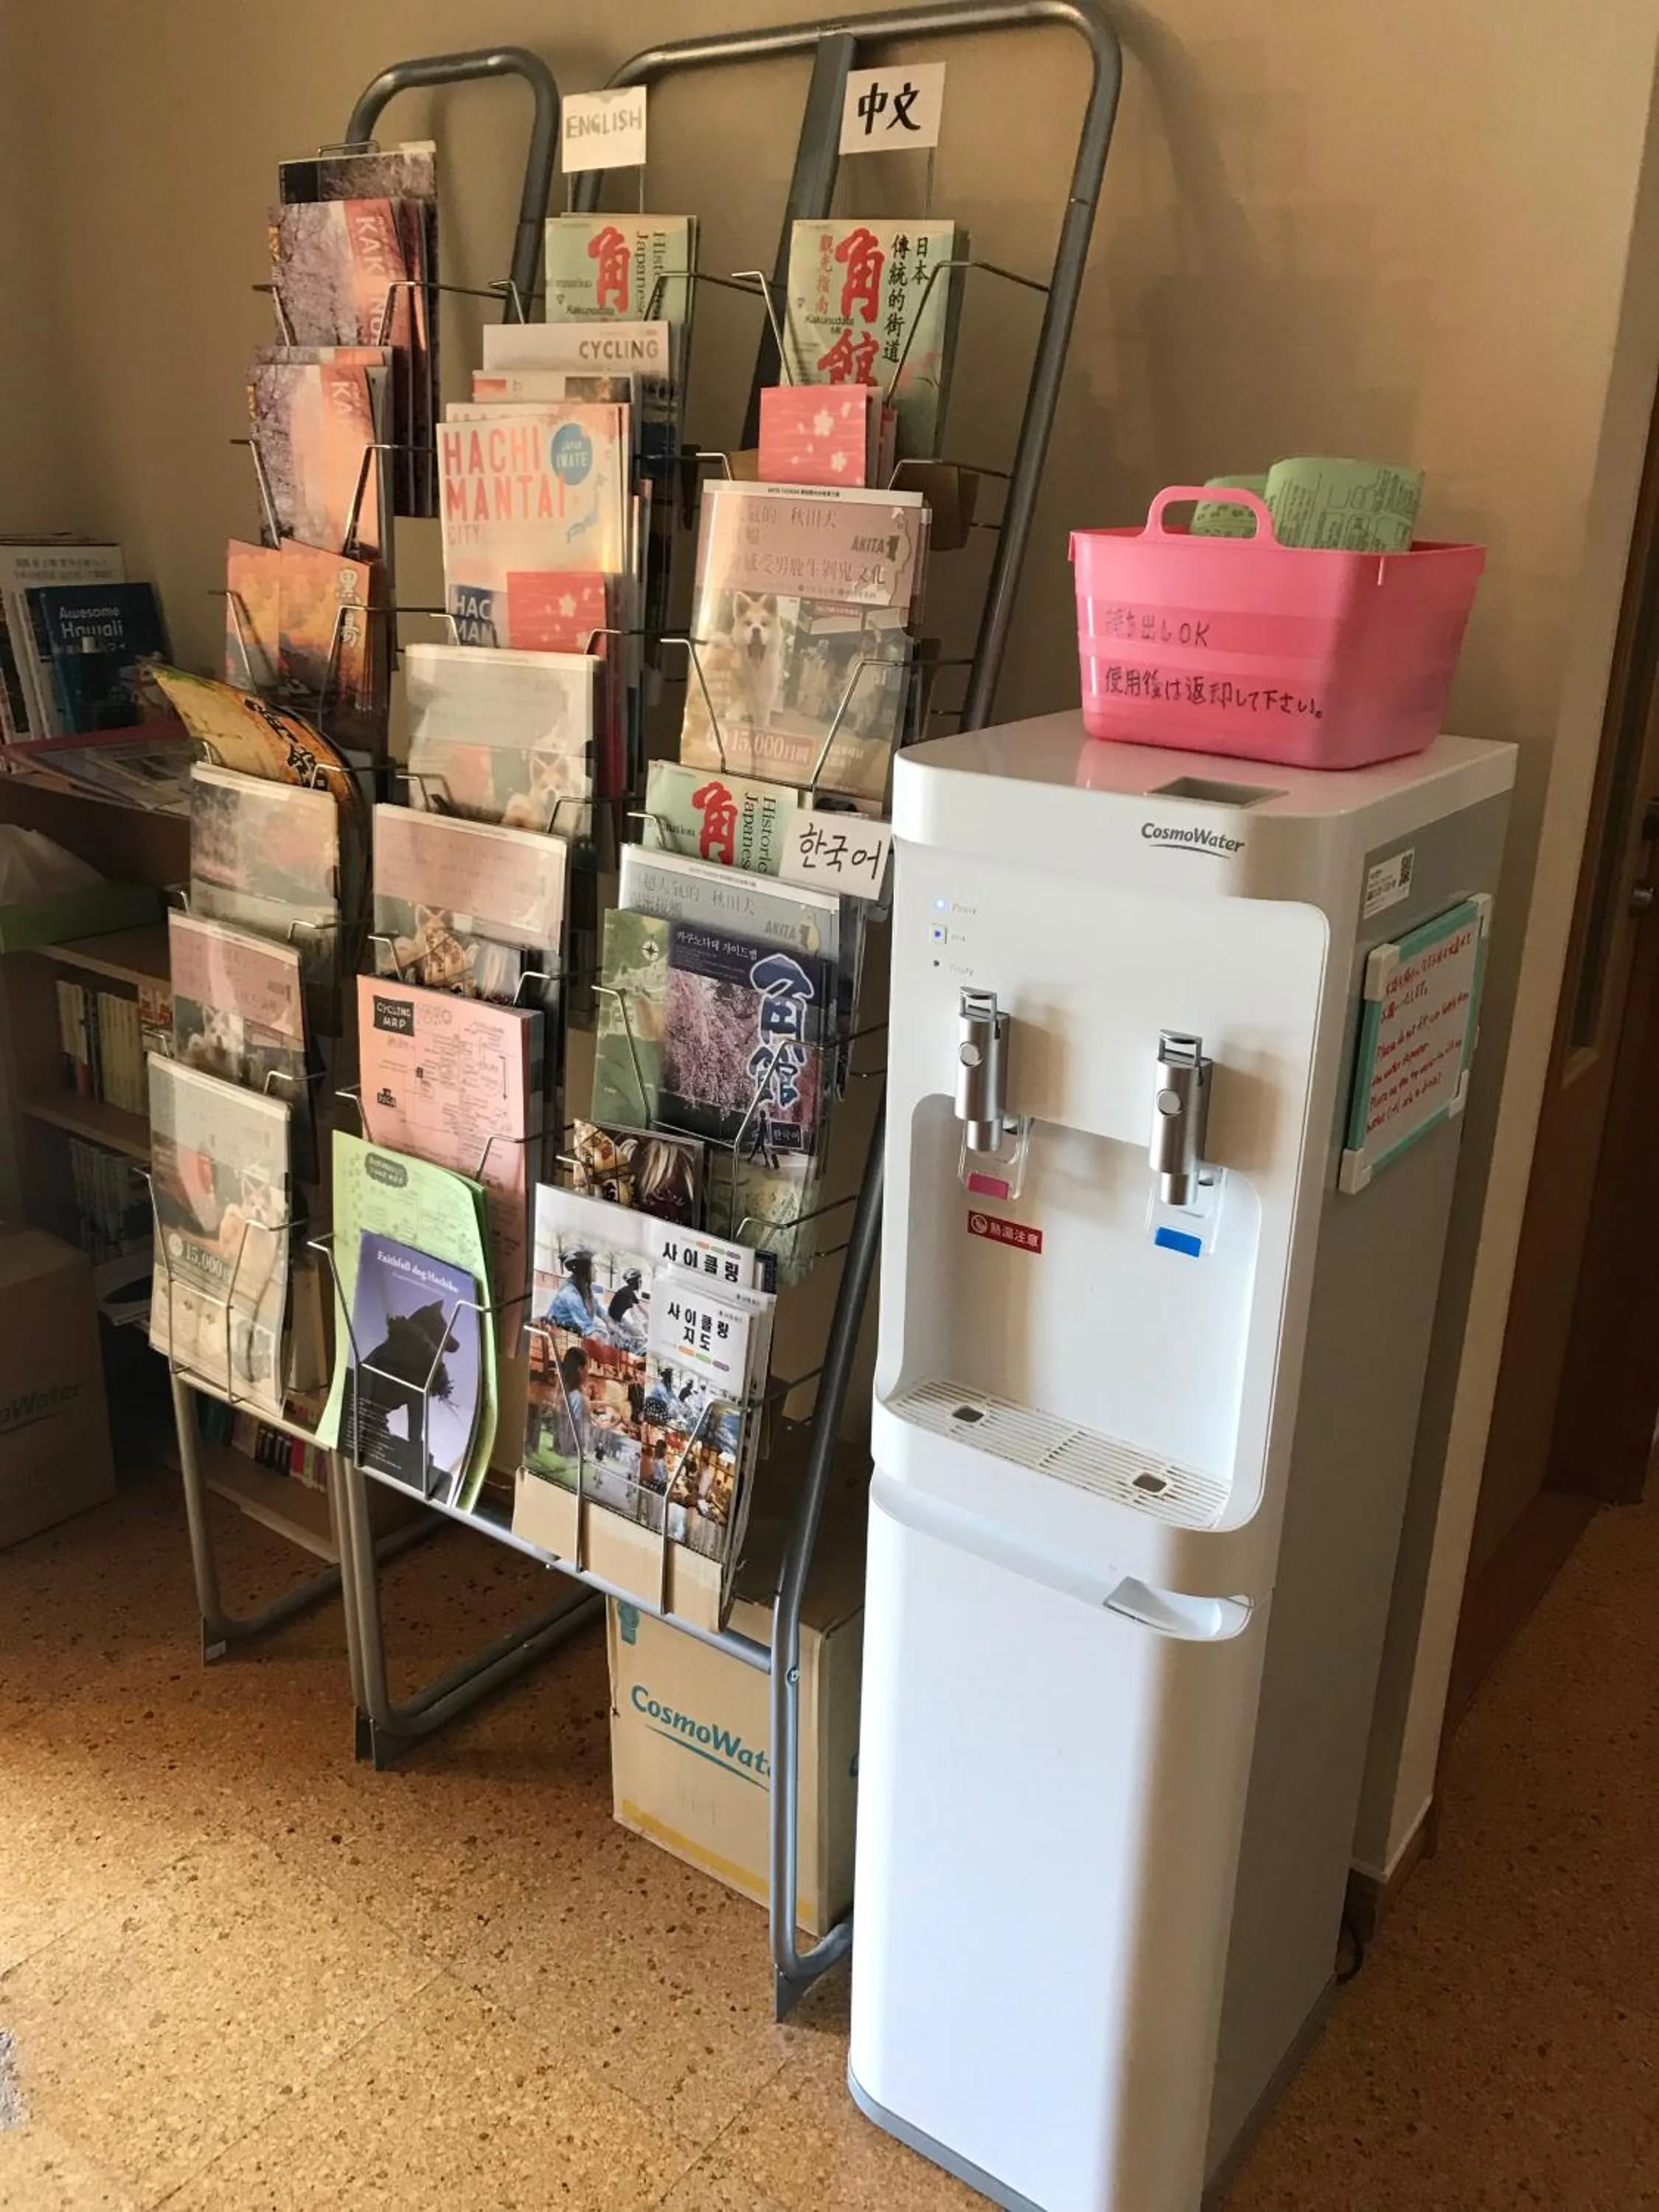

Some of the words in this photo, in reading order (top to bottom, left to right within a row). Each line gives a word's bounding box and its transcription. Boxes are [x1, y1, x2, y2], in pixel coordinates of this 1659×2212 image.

[566, 107, 642, 140] ENGLISH
[858, 83, 922, 135] 中文
[911, 237, 931, 287] 日本
[579, 339, 659, 359] CYCLING
[442, 425, 540, 476] HACHI
[557, 453, 589, 468] IWATE
[445, 473, 566, 522] MANTAI
[448, 524, 480, 546] CITY
[851, 535, 885, 554] AKITA
[58, 605, 120, 619] Awesome
[800, 823, 883, 880] 한국어
[1141, 822, 1246, 852] CosmoWater
[765, 919, 796, 939] AKITA
[662, 1242, 740, 1283] 사이클링
[667, 1302, 729, 1339] 사이클링
[684, 1326, 712, 1352] 지도
